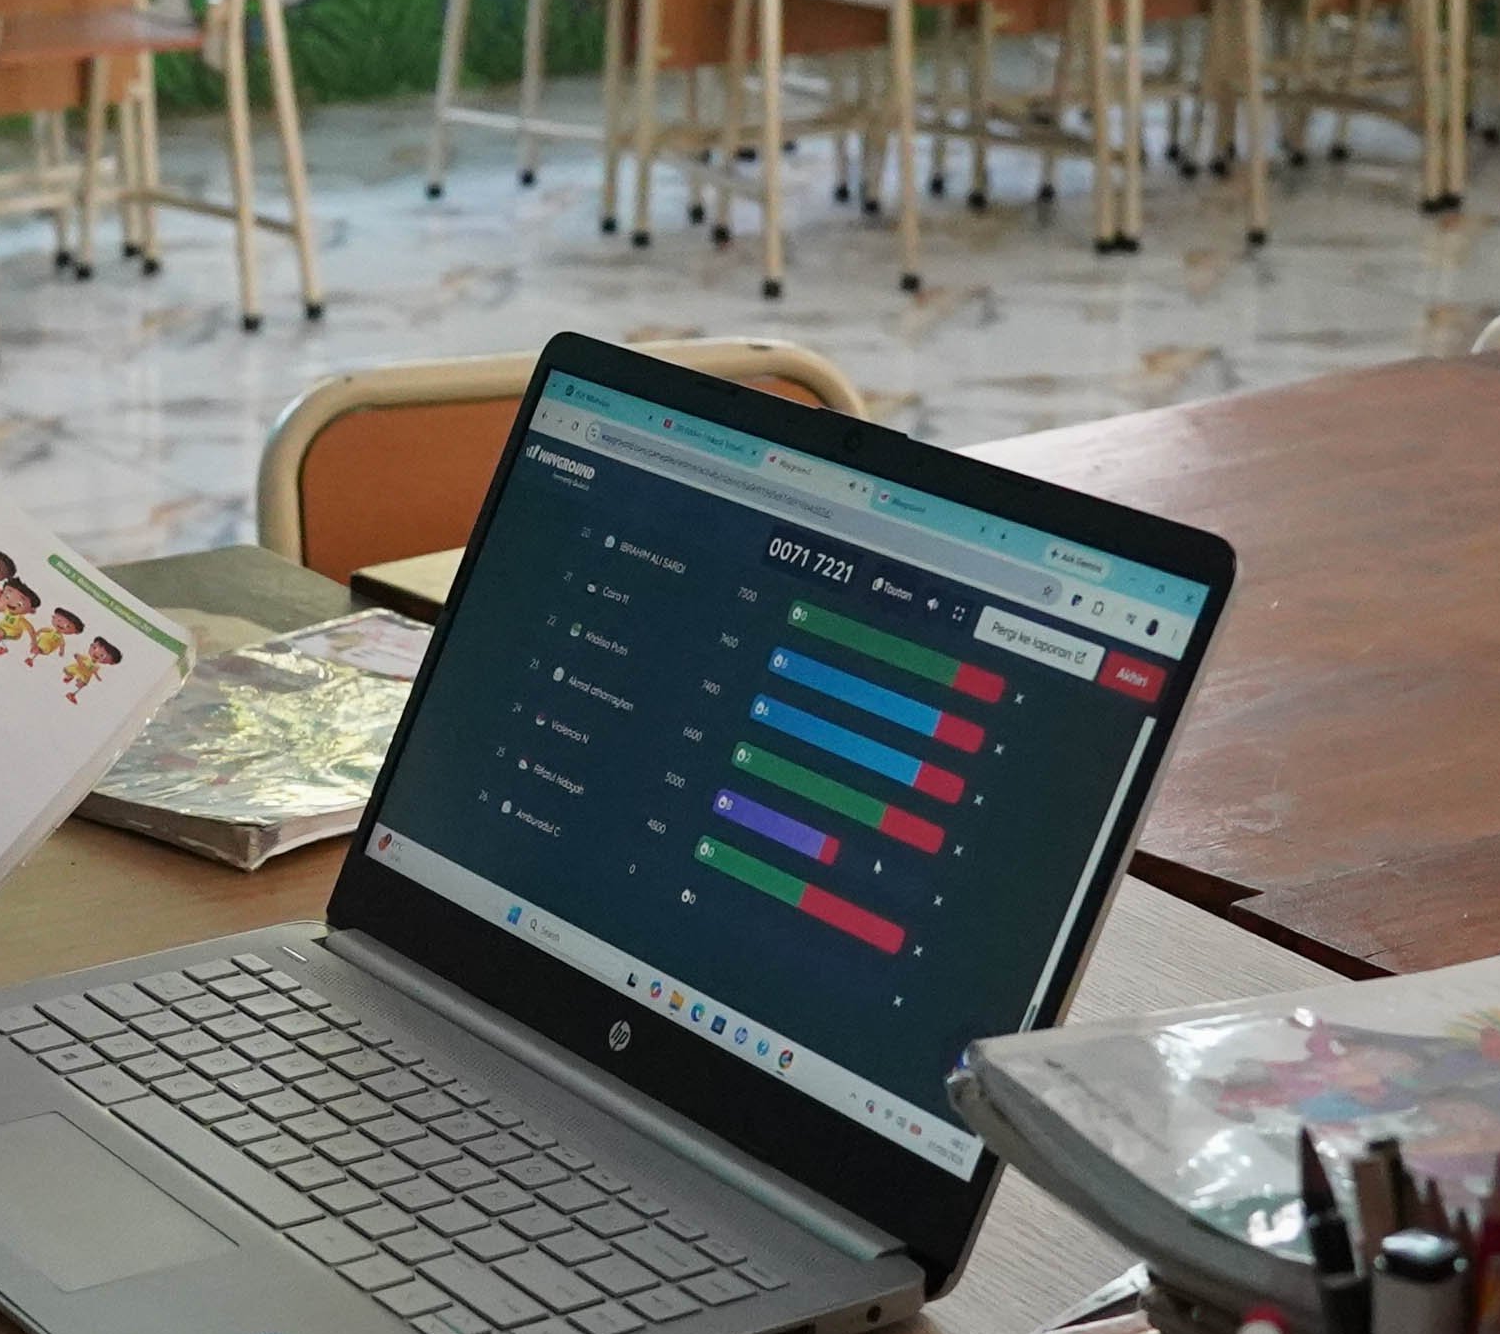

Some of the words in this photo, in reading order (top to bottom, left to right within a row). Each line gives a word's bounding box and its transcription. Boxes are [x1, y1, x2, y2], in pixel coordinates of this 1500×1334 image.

[538, 448, 595, 480] WAYGROUND
[769, 538, 811, 567] 0071
[813, 553, 855, 583] 7221
[883, 580, 913, 601] Tautan
[992, 621, 1018, 642] Pergi
[1018, 629, 1032, 645] ke
[1032, 635, 1074, 661] laporan
[1115, 666, 1150, 688] Akhiri
[553, 826, 562, 838] C
[629, 864, 636, 875] 0
[609, 1020, 631, 1052] hp
